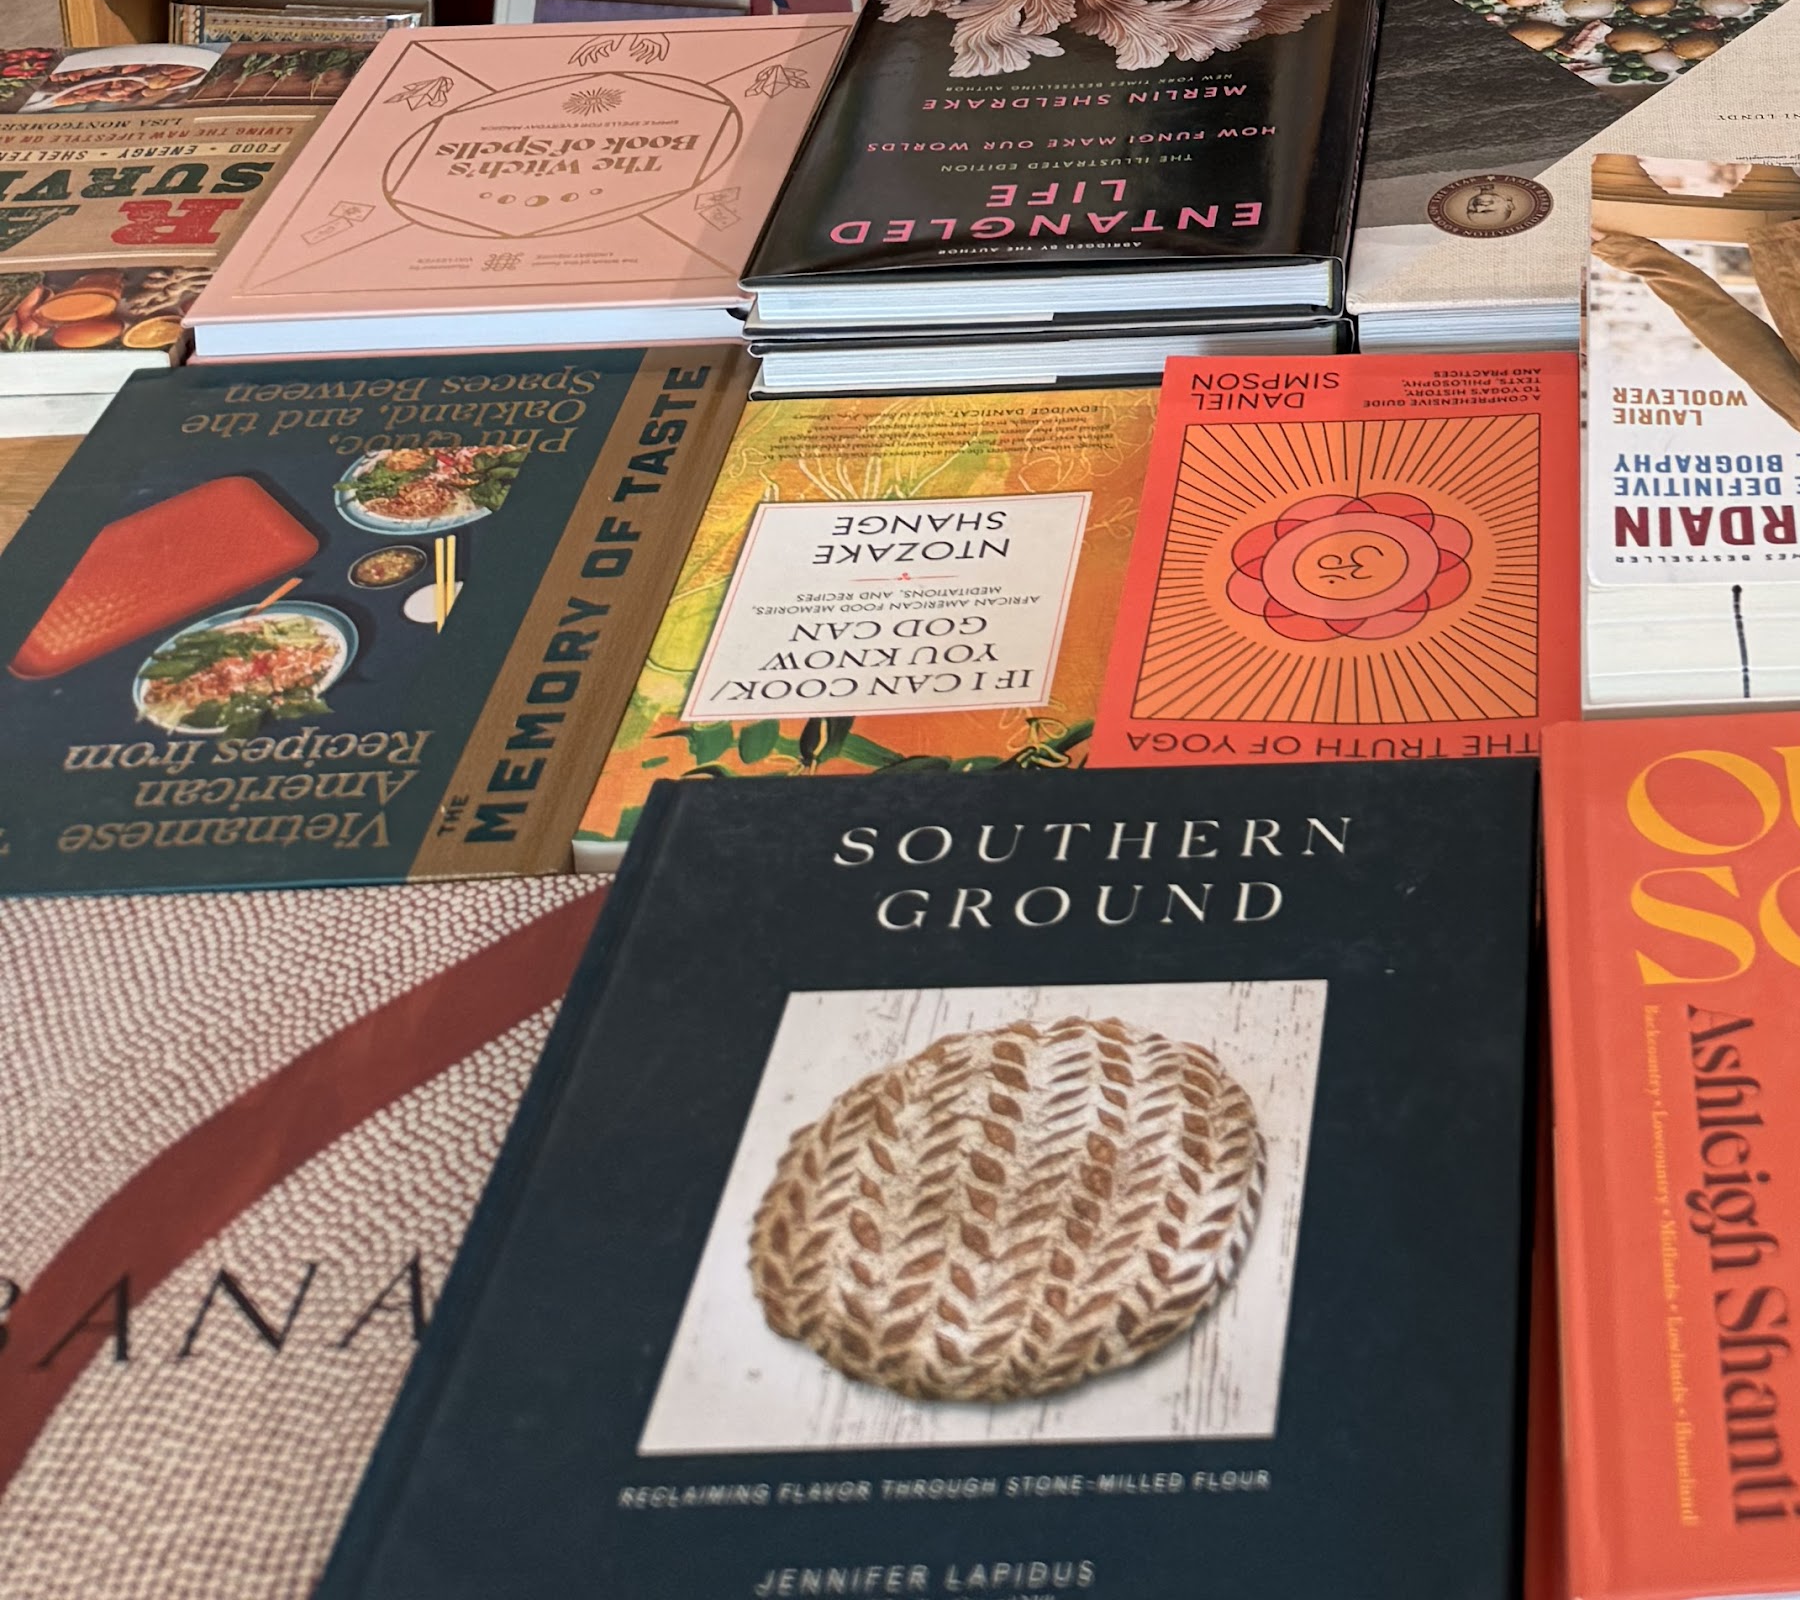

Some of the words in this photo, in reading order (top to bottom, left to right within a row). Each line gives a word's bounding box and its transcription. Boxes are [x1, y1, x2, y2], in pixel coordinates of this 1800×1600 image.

[435, 135, 553, 160] Spells
[550, 137, 596, 158] of
[602, 134, 701, 155] Book
[446, 158, 581, 179] Witch's
[592, 155, 663, 175] The
[985, 180, 1127, 207] LIFE
[829, 202, 1264, 246] ENTANGLED
[1191, 371, 1339, 392] SIMPSON
[1191, 389, 1305, 410] DANIEL
[834, 513, 1008, 536] SHANGE
[814, 538, 1011, 564] NTOZAKE
[831, 814, 1355, 870] SOUTHERN
[875, 880, 1289, 934] GROUND
[1685, 1002, 1783, 1275] Ashleigh
[754, 1562, 930, 1598] JENNIFER
[945, 1560, 1097, 1592] LAPIDUS
